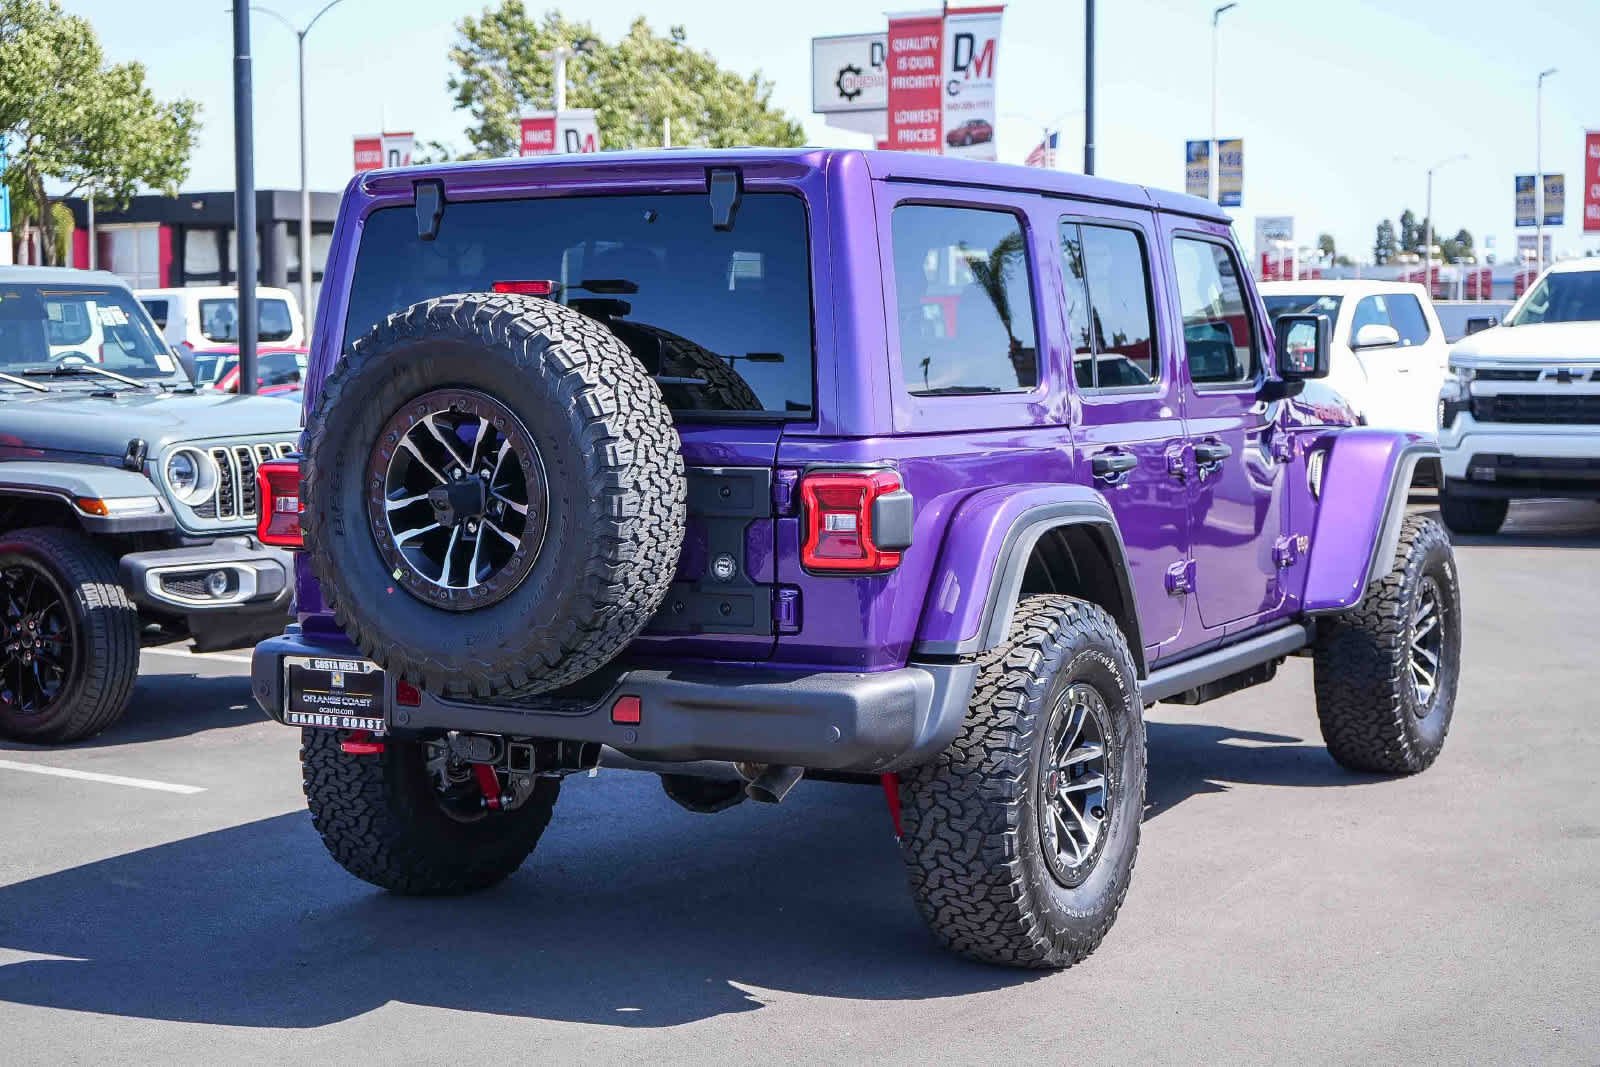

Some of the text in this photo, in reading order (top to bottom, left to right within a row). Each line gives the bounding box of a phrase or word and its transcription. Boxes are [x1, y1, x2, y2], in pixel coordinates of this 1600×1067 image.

[892, 36, 938, 52] QUALITY
[908, 55, 935, 70] OUR
[953, 32, 996, 80] DM
[898, 58, 906, 70] IS
[891, 73, 941, 89] PRIORITY
[894, 109, 939, 125] LOWEST
[897, 128, 937, 143] PRICES
[314, 660, 358, 671] COSTA MESA
[303, 695, 372, 706] ORANGE COAST
[319, 707, 354, 716] ocauto.com
[292, 714, 382, 729] ORANGE COAST
